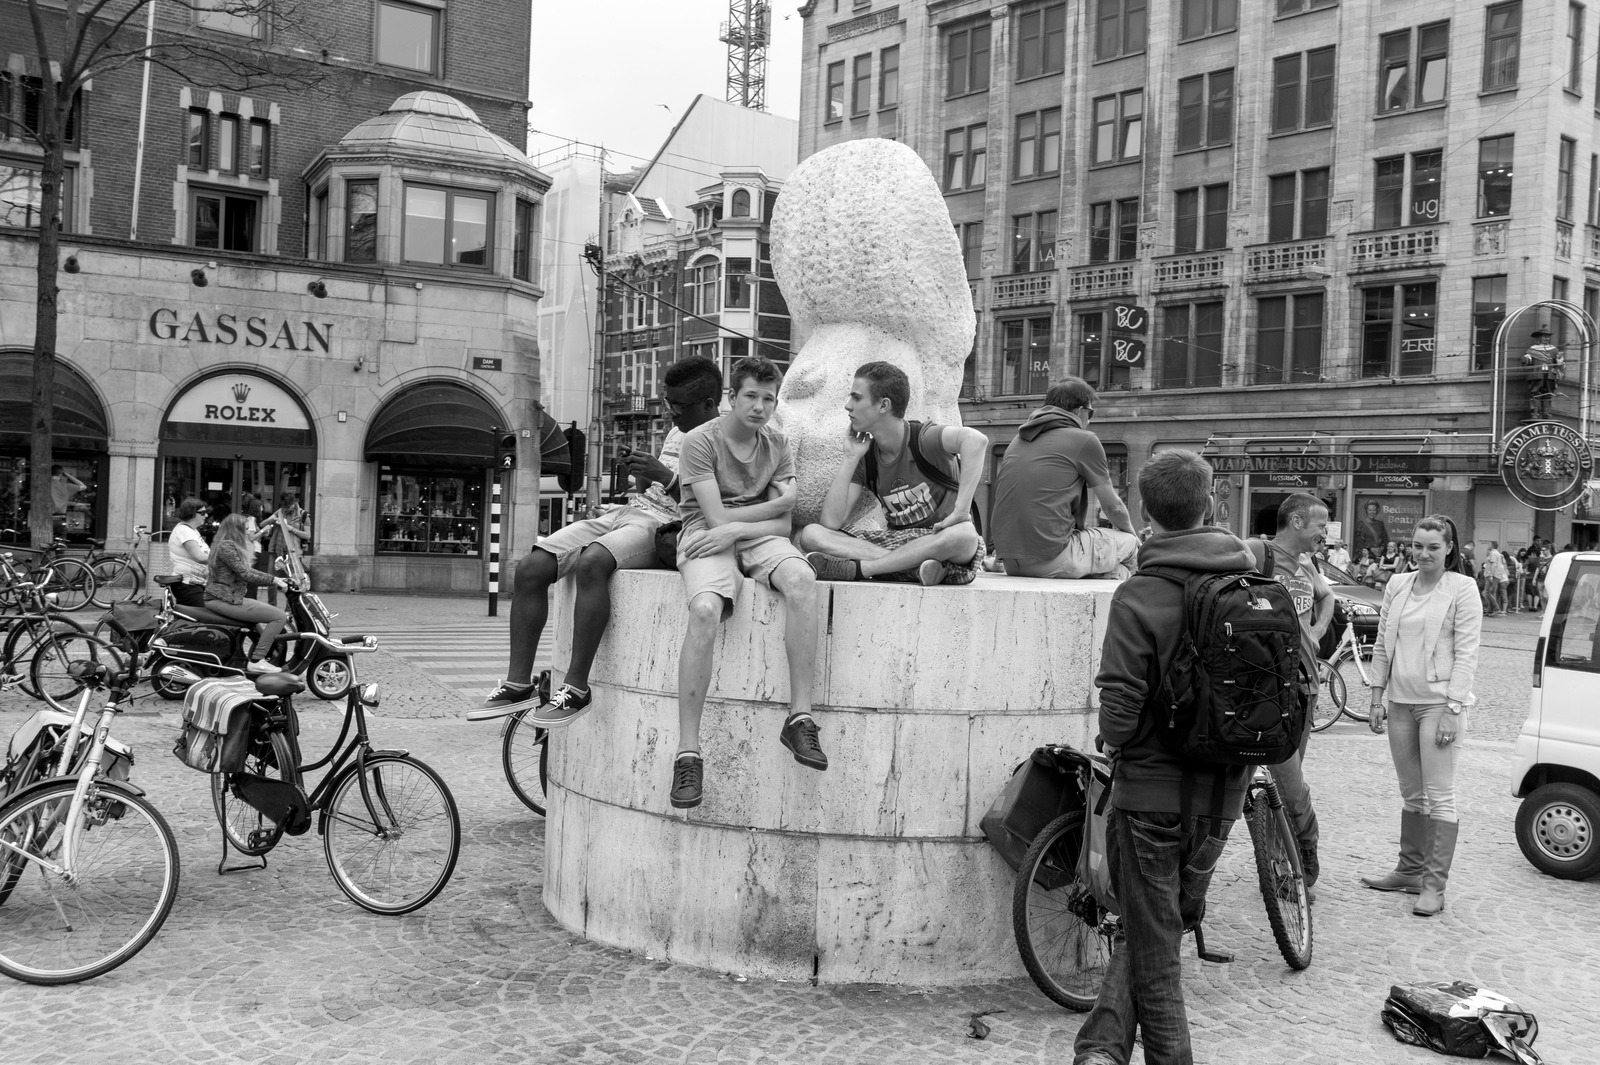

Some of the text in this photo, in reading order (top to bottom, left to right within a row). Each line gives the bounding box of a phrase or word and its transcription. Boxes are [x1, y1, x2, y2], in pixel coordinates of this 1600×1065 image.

[1412, 199, 1439, 219] ug
[149, 308, 335, 353] GASSAN
[205, 404, 276, 422] ROLEX
[1504, 425, 1591, 469] MADAME TUSSAUD
[1212, 456, 1361, 471] MADAME TUSSAUD
[1388, 515, 1419, 524] Beatri
